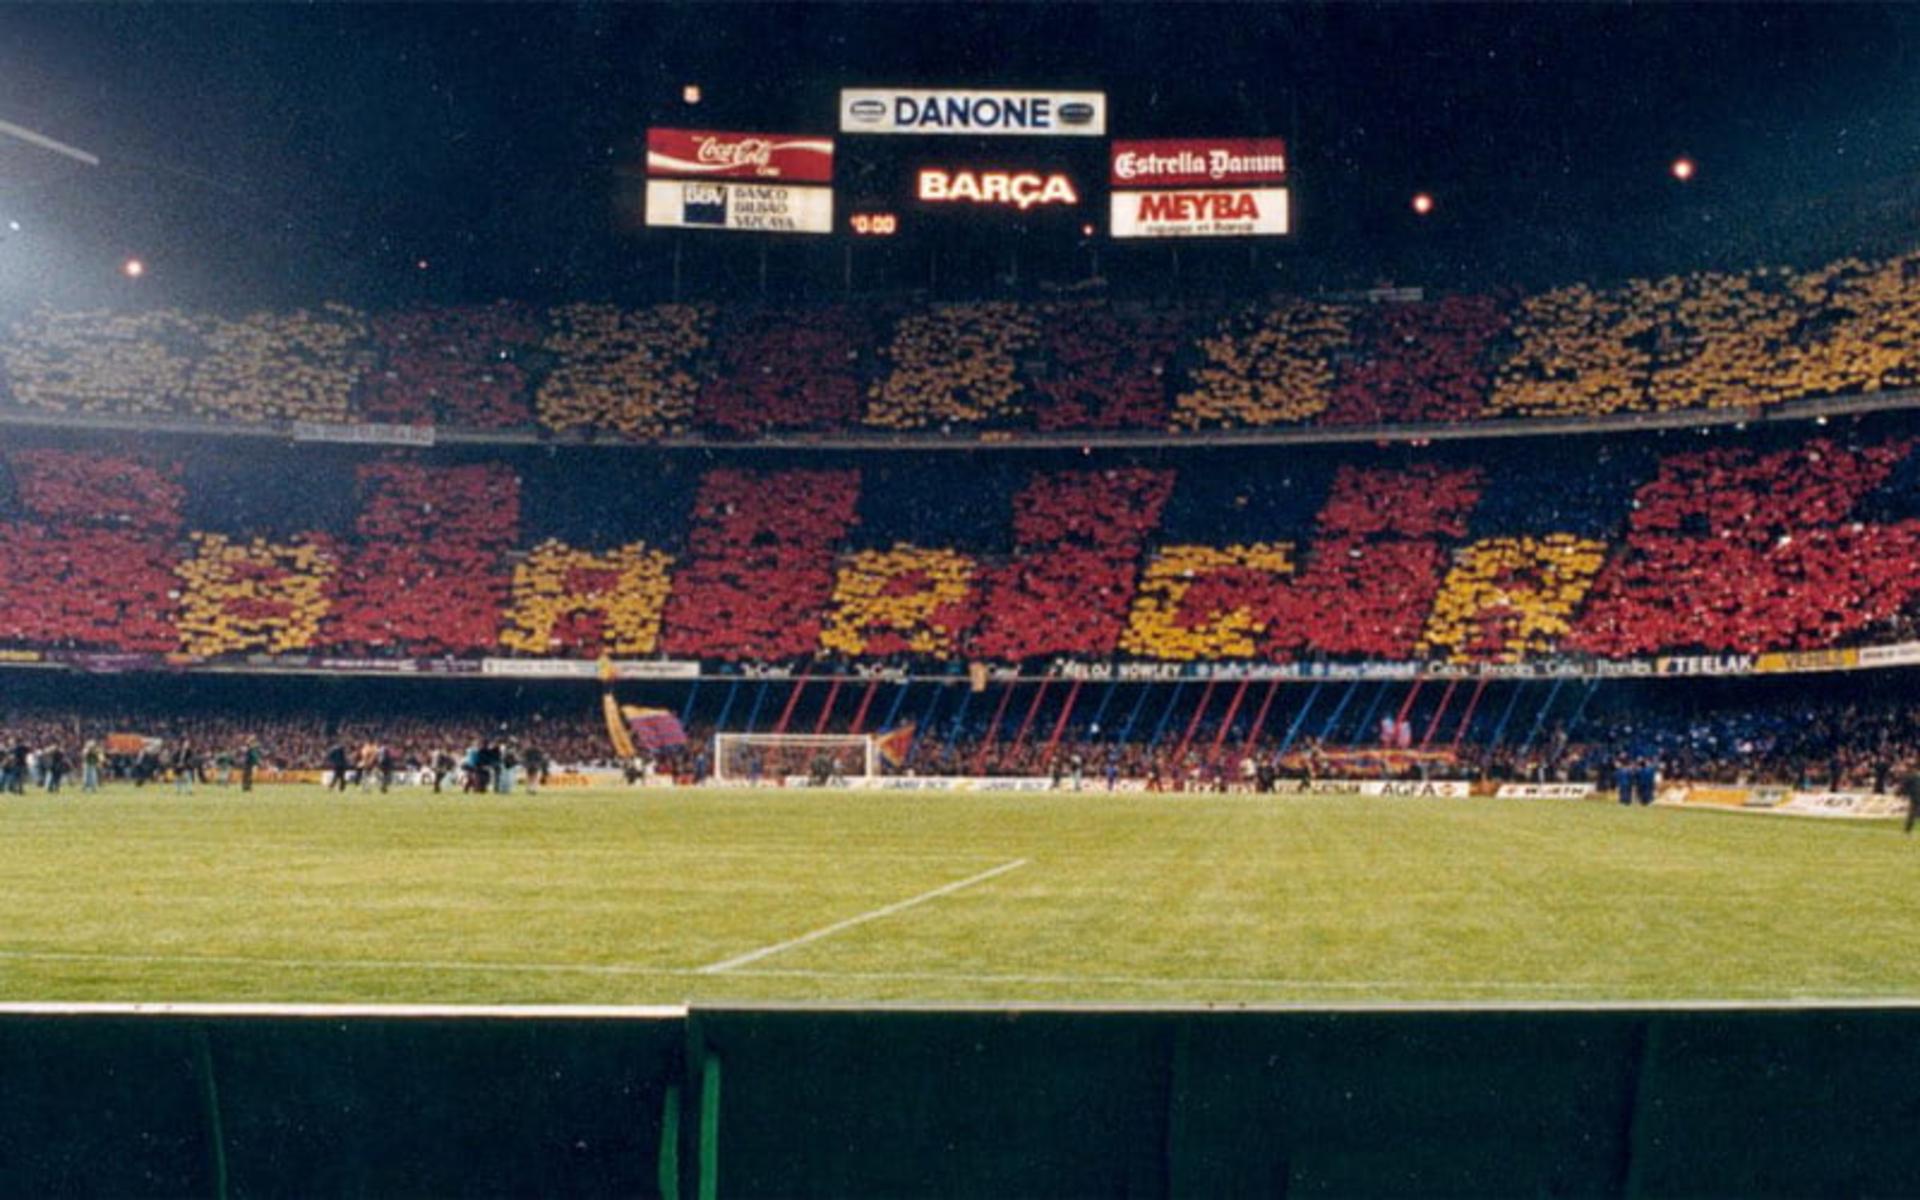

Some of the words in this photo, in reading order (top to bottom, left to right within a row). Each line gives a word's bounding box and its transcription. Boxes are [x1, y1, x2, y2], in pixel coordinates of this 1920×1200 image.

[895, 96, 1050, 127] DANONE
[1115, 152, 1206, 178] Estrella
[1209, 150, 1285, 179] Damm
[735, 189, 788, 199] BANCO
[918, 170, 1078, 210] BARÇA
[735, 202, 788, 213] BILBAO
[1139, 193, 1259, 221] MEYBA
[735, 216, 795, 229] VIZCAYA
[1380, 783, 1437, 797] AGFA
